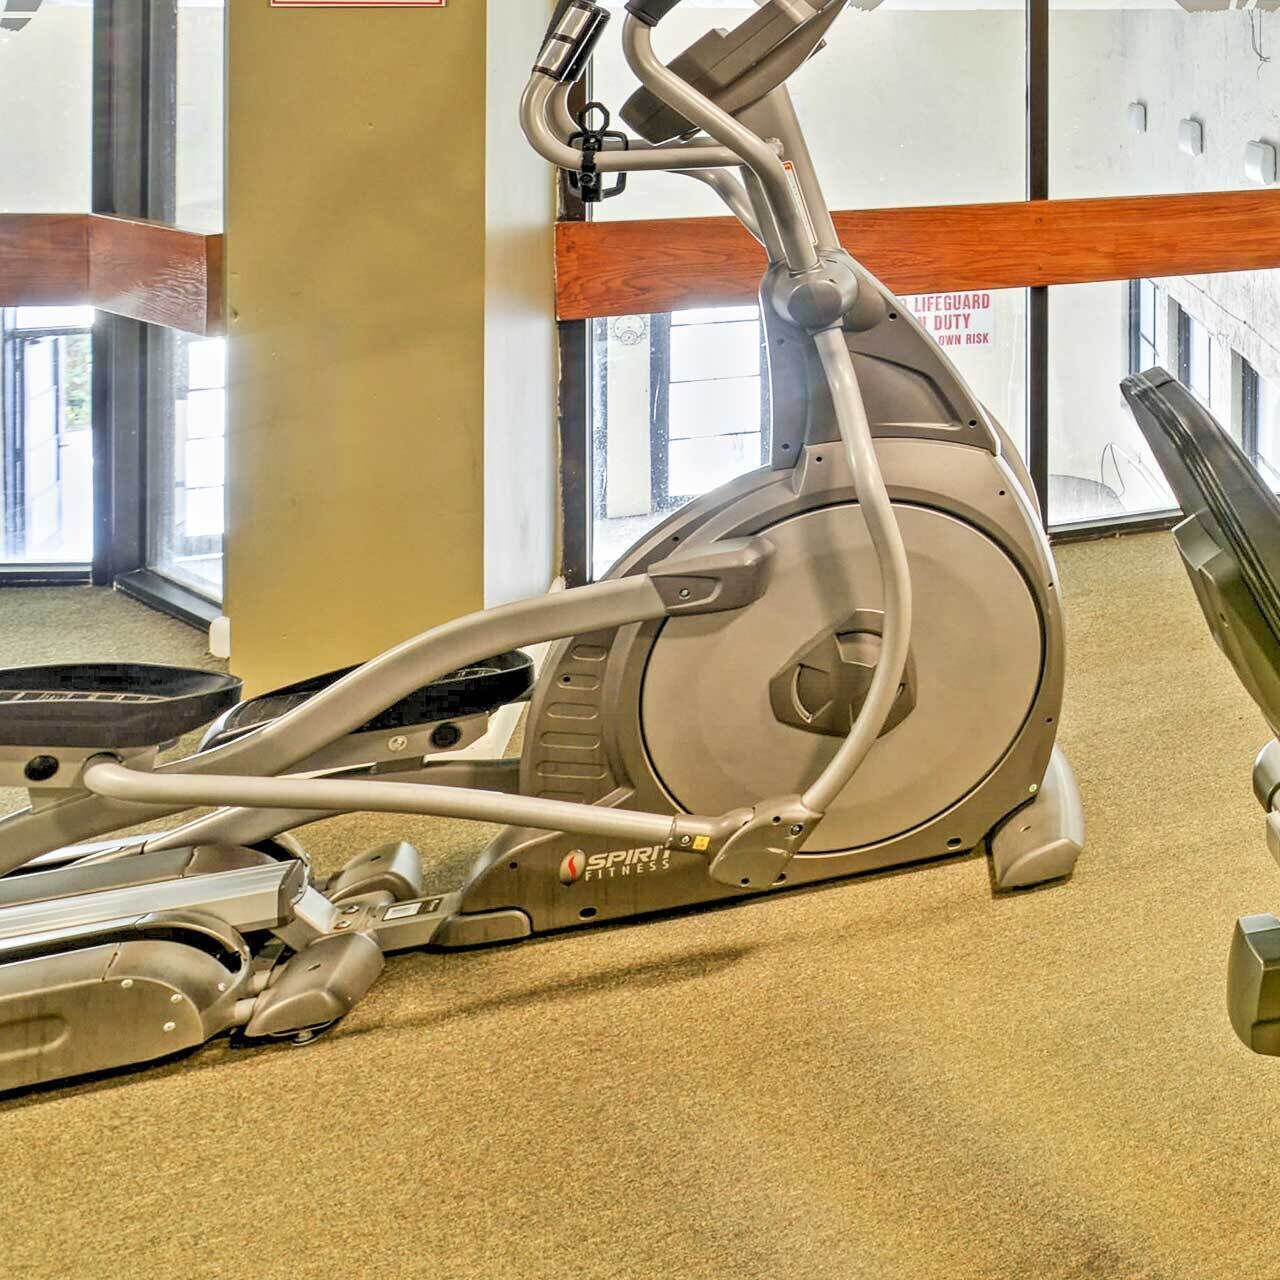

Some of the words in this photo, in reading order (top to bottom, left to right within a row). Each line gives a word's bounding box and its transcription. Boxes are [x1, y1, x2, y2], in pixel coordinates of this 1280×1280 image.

[914, 293, 990, 313] LIFEGUARD
[934, 313, 971, 331] DUTY
[938, 333, 961, 346] OWN
[965, 332, 989, 345] RISK
[586, 845, 672, 871] SPIRIT
[585, 859, 671, 882] FITNESS
